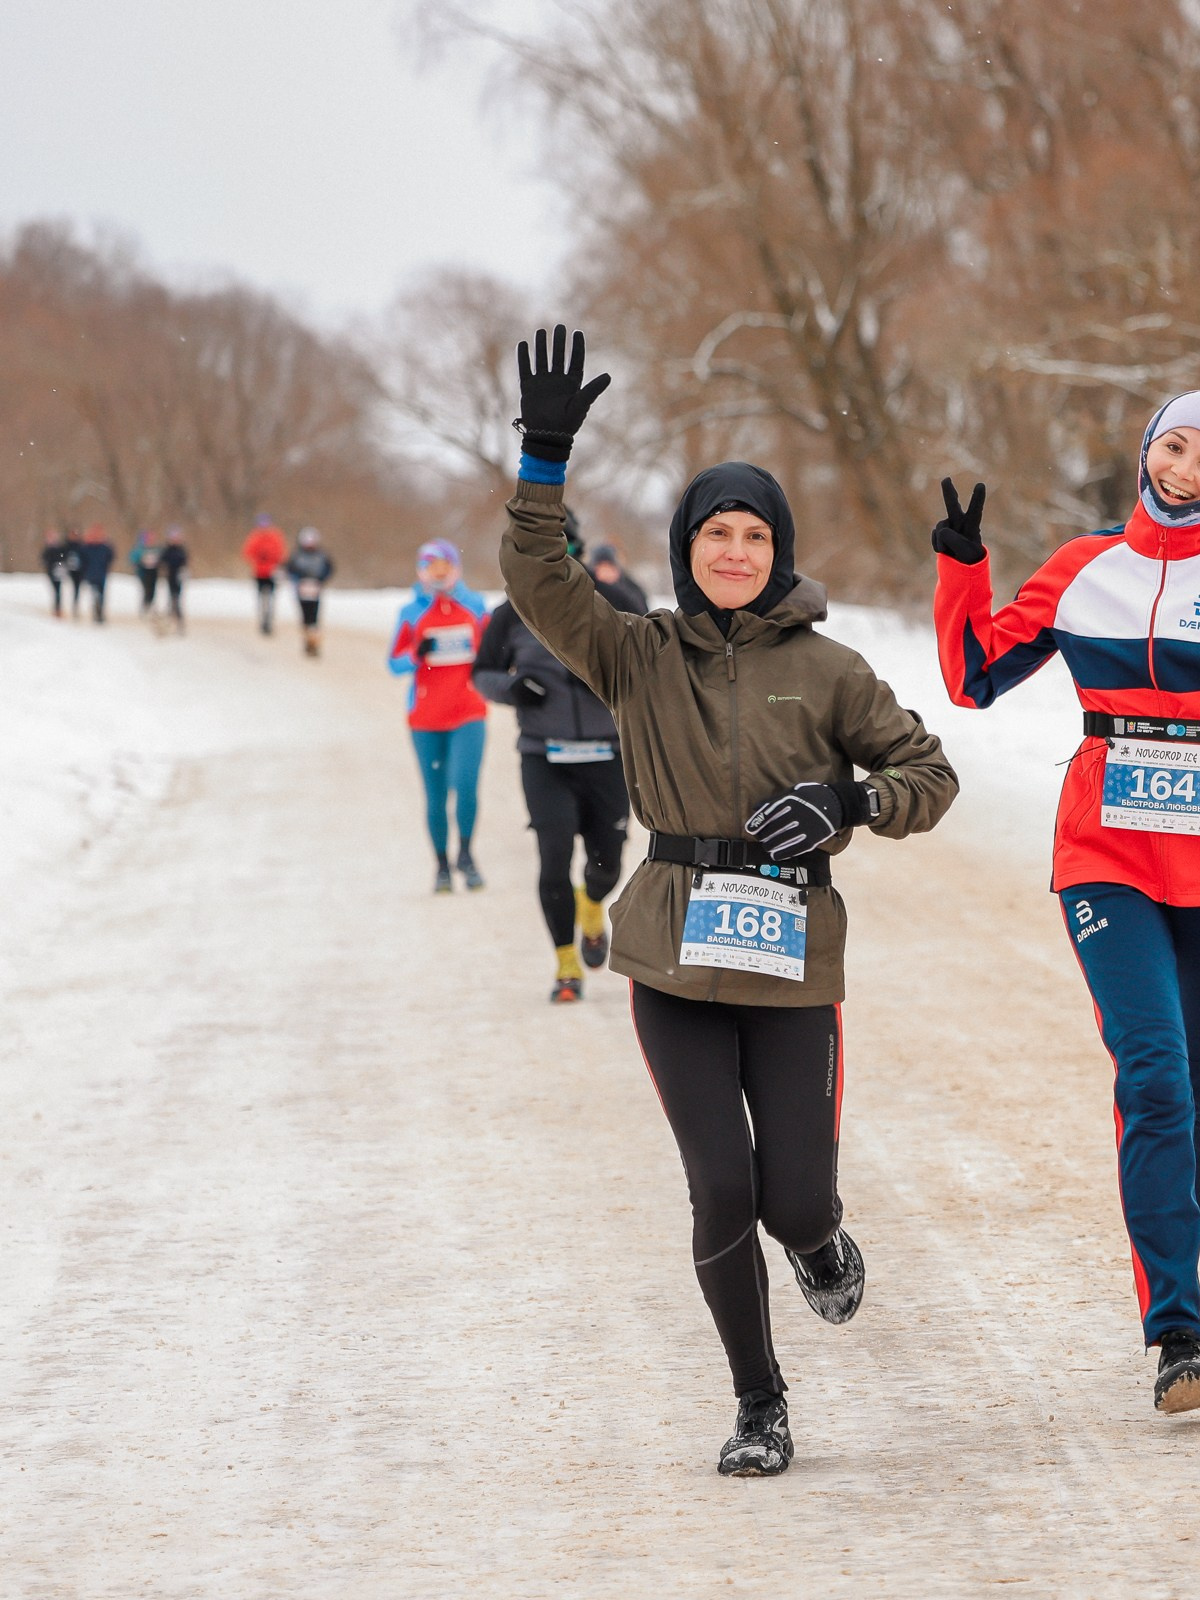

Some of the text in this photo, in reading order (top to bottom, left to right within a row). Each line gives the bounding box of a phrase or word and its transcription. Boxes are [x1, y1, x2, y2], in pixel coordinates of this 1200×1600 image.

[1134, 748, 1182, 761] NOVGOROD
[1184, 752, 1198, 764] ICE
[1130, 768, 1196, 803] 164
[1121, 799, 1165, 811] БЫСТРОВА
[720, 882, 770, 898] NOVGOROD
[771, 890, 784, 904] ICE
[714, 903, 782, 942] 168
[706, 935, 759, 949] ВАСИЛЬЕВА
[760, 942, 786, 954] ОЛЬГА
[825, 1033, 835, 1097] noname
